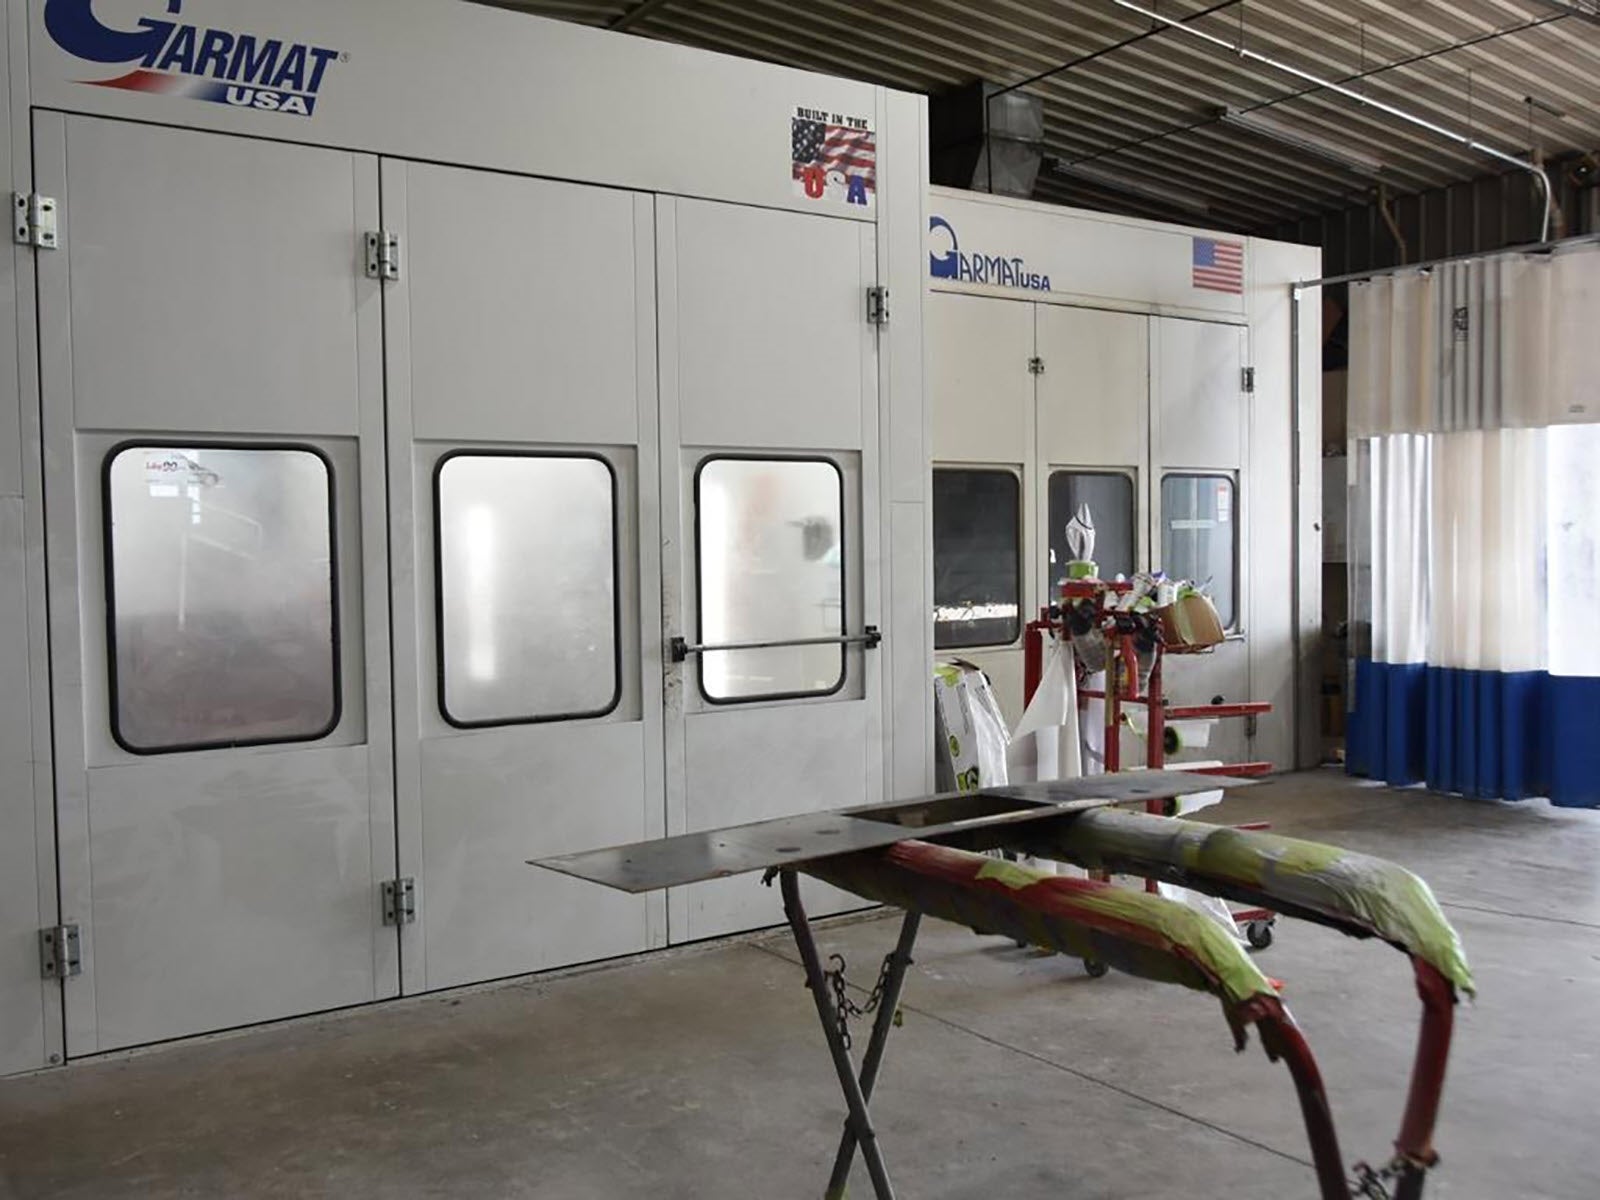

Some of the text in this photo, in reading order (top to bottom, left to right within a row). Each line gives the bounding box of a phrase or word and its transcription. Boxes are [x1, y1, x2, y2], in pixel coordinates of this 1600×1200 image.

[226, 86, 309, 115] USA
[797, 107, 868, 129] BUILT IN THE
